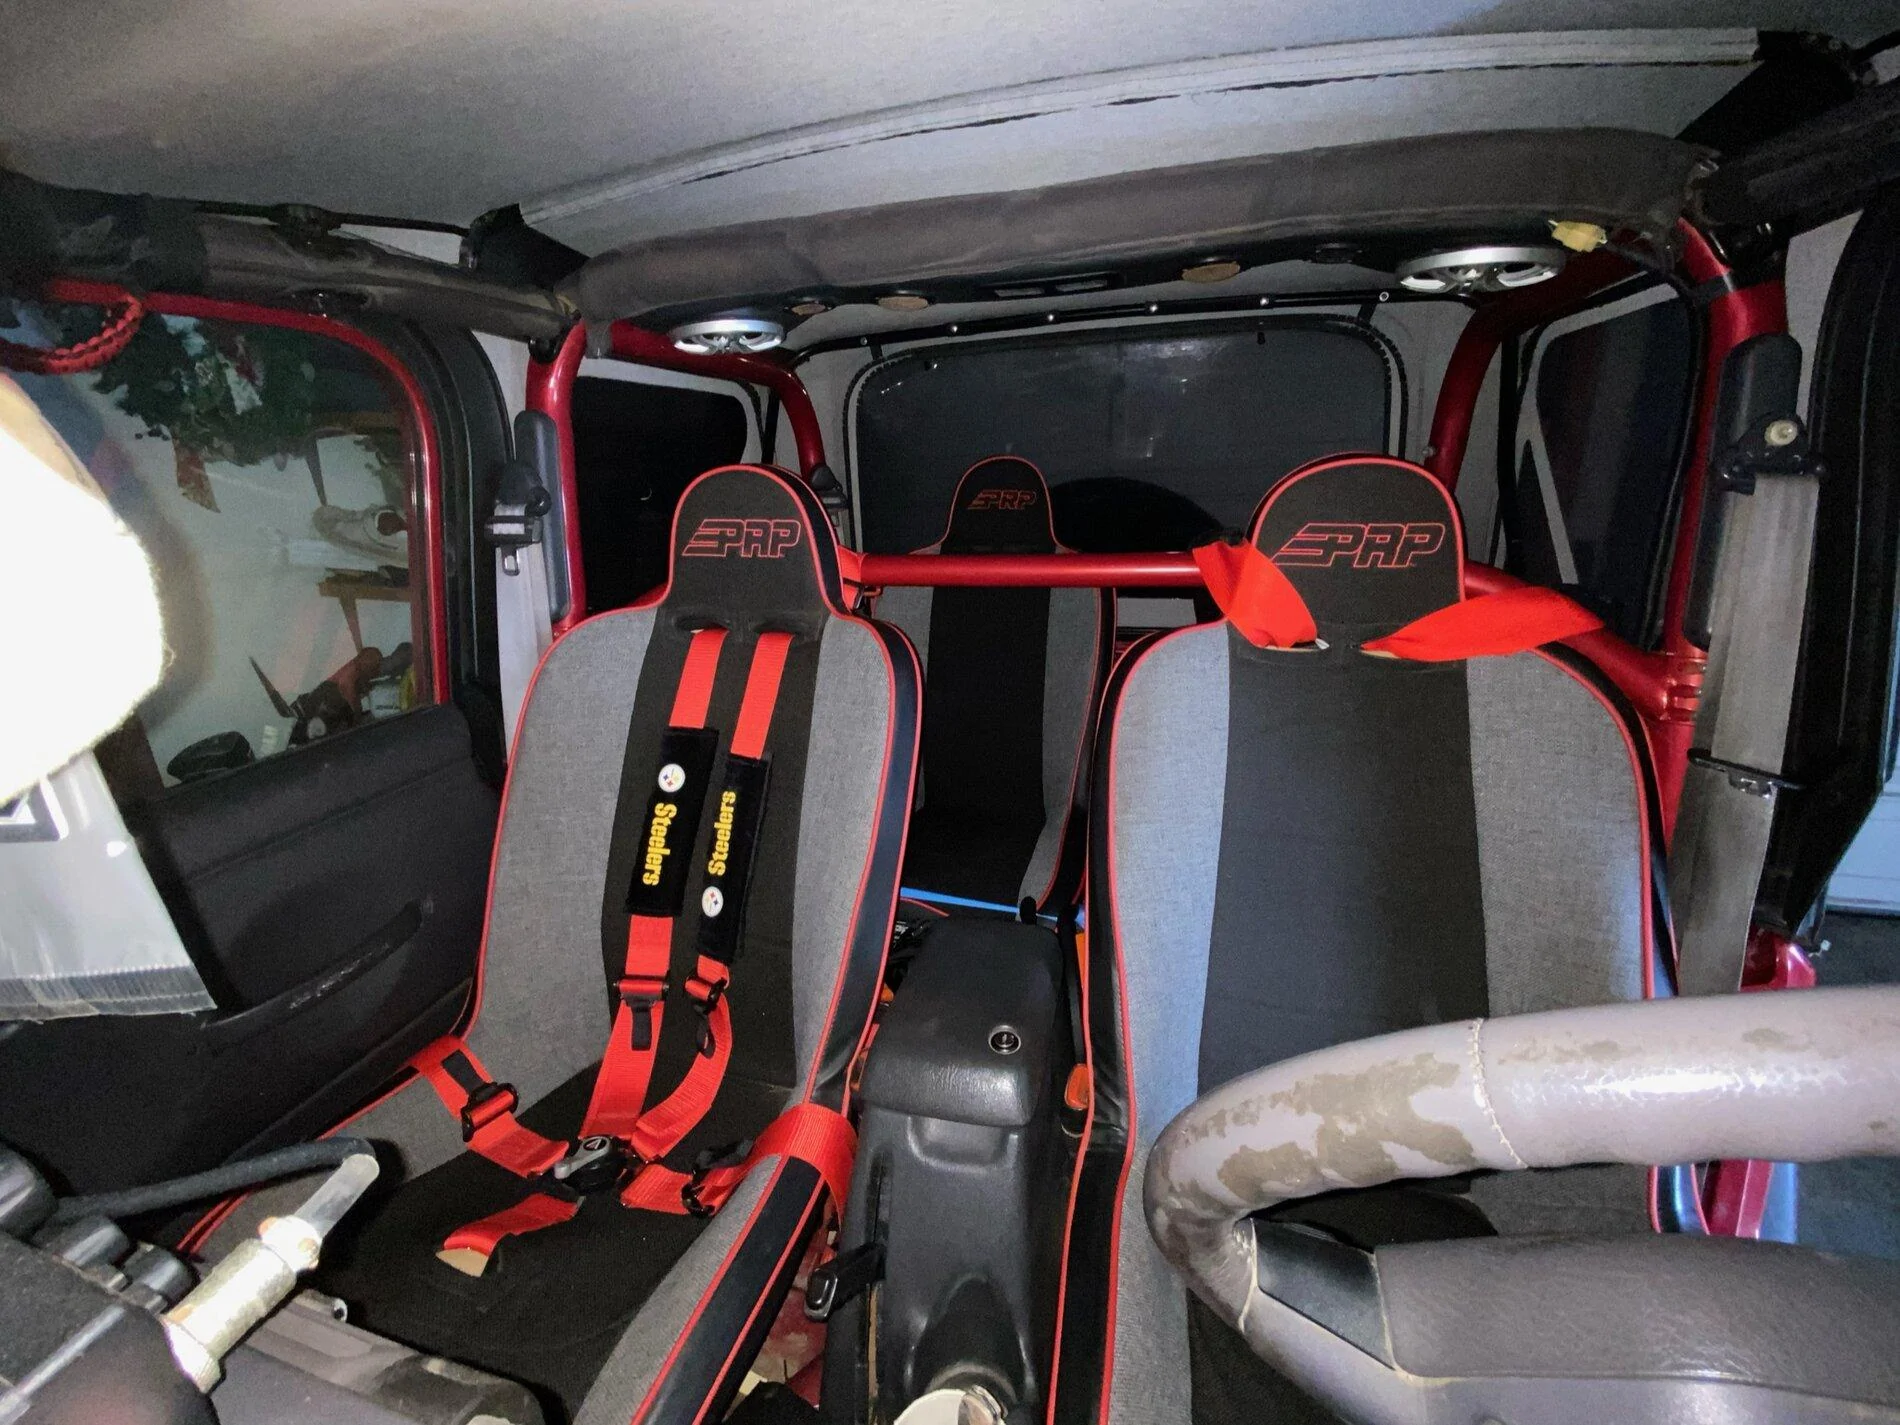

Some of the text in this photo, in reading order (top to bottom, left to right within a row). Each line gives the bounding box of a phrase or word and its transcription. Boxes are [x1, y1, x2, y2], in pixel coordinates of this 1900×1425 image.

[967, 489, 1037, 510] PRP
[682, 519, 801, 558] PRP
[1271, 522, 1446, 567] PRP
[642, 802, 677, 886] Steelers
[708, 791, 736, 876] Steelers
